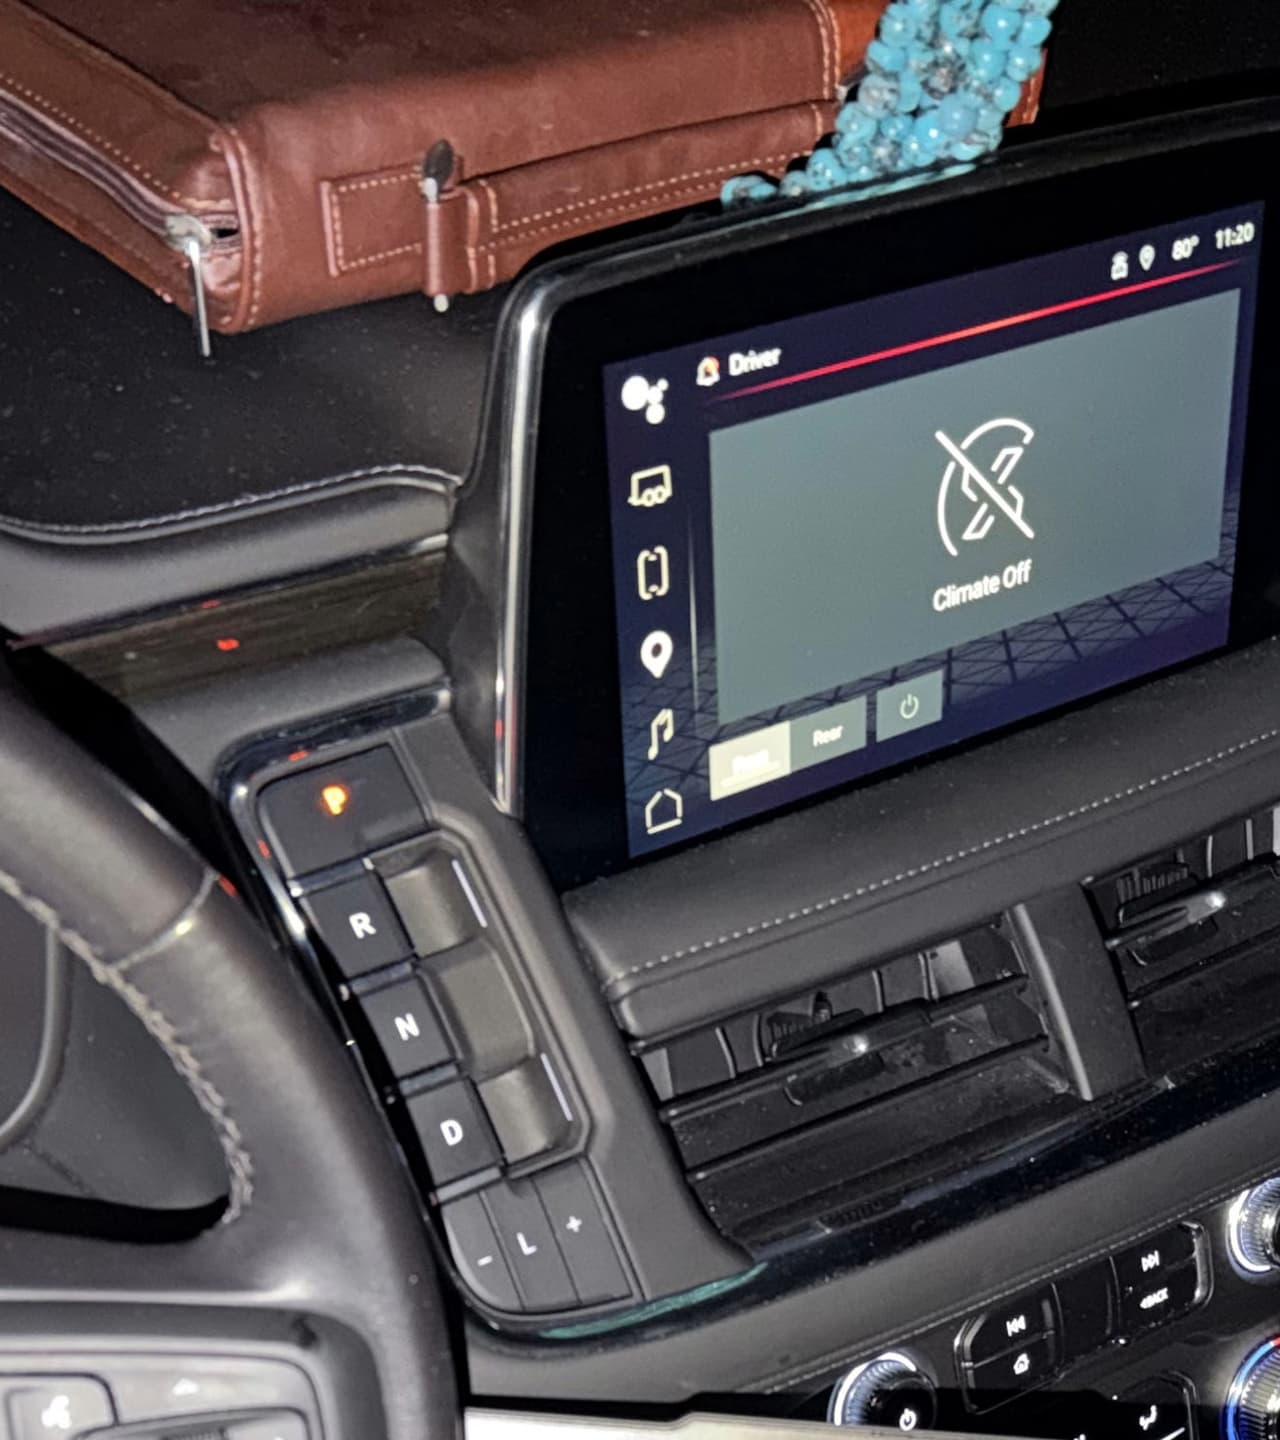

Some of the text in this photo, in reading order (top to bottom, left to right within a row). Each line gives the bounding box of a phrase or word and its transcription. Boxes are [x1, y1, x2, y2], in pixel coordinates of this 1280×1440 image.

[1215, 221, 1255, 250] 11:20
[728, 347, 782, 376] Driver
[932, 558, 1033, 612] Climate Off
[323, 786, 347, 815] P
[348, 911, 377, 939] R
[394, 1013, 420, 1041] N
[440, 1119, 464, 1147] D
[516, 1232, 537, 1256] L
